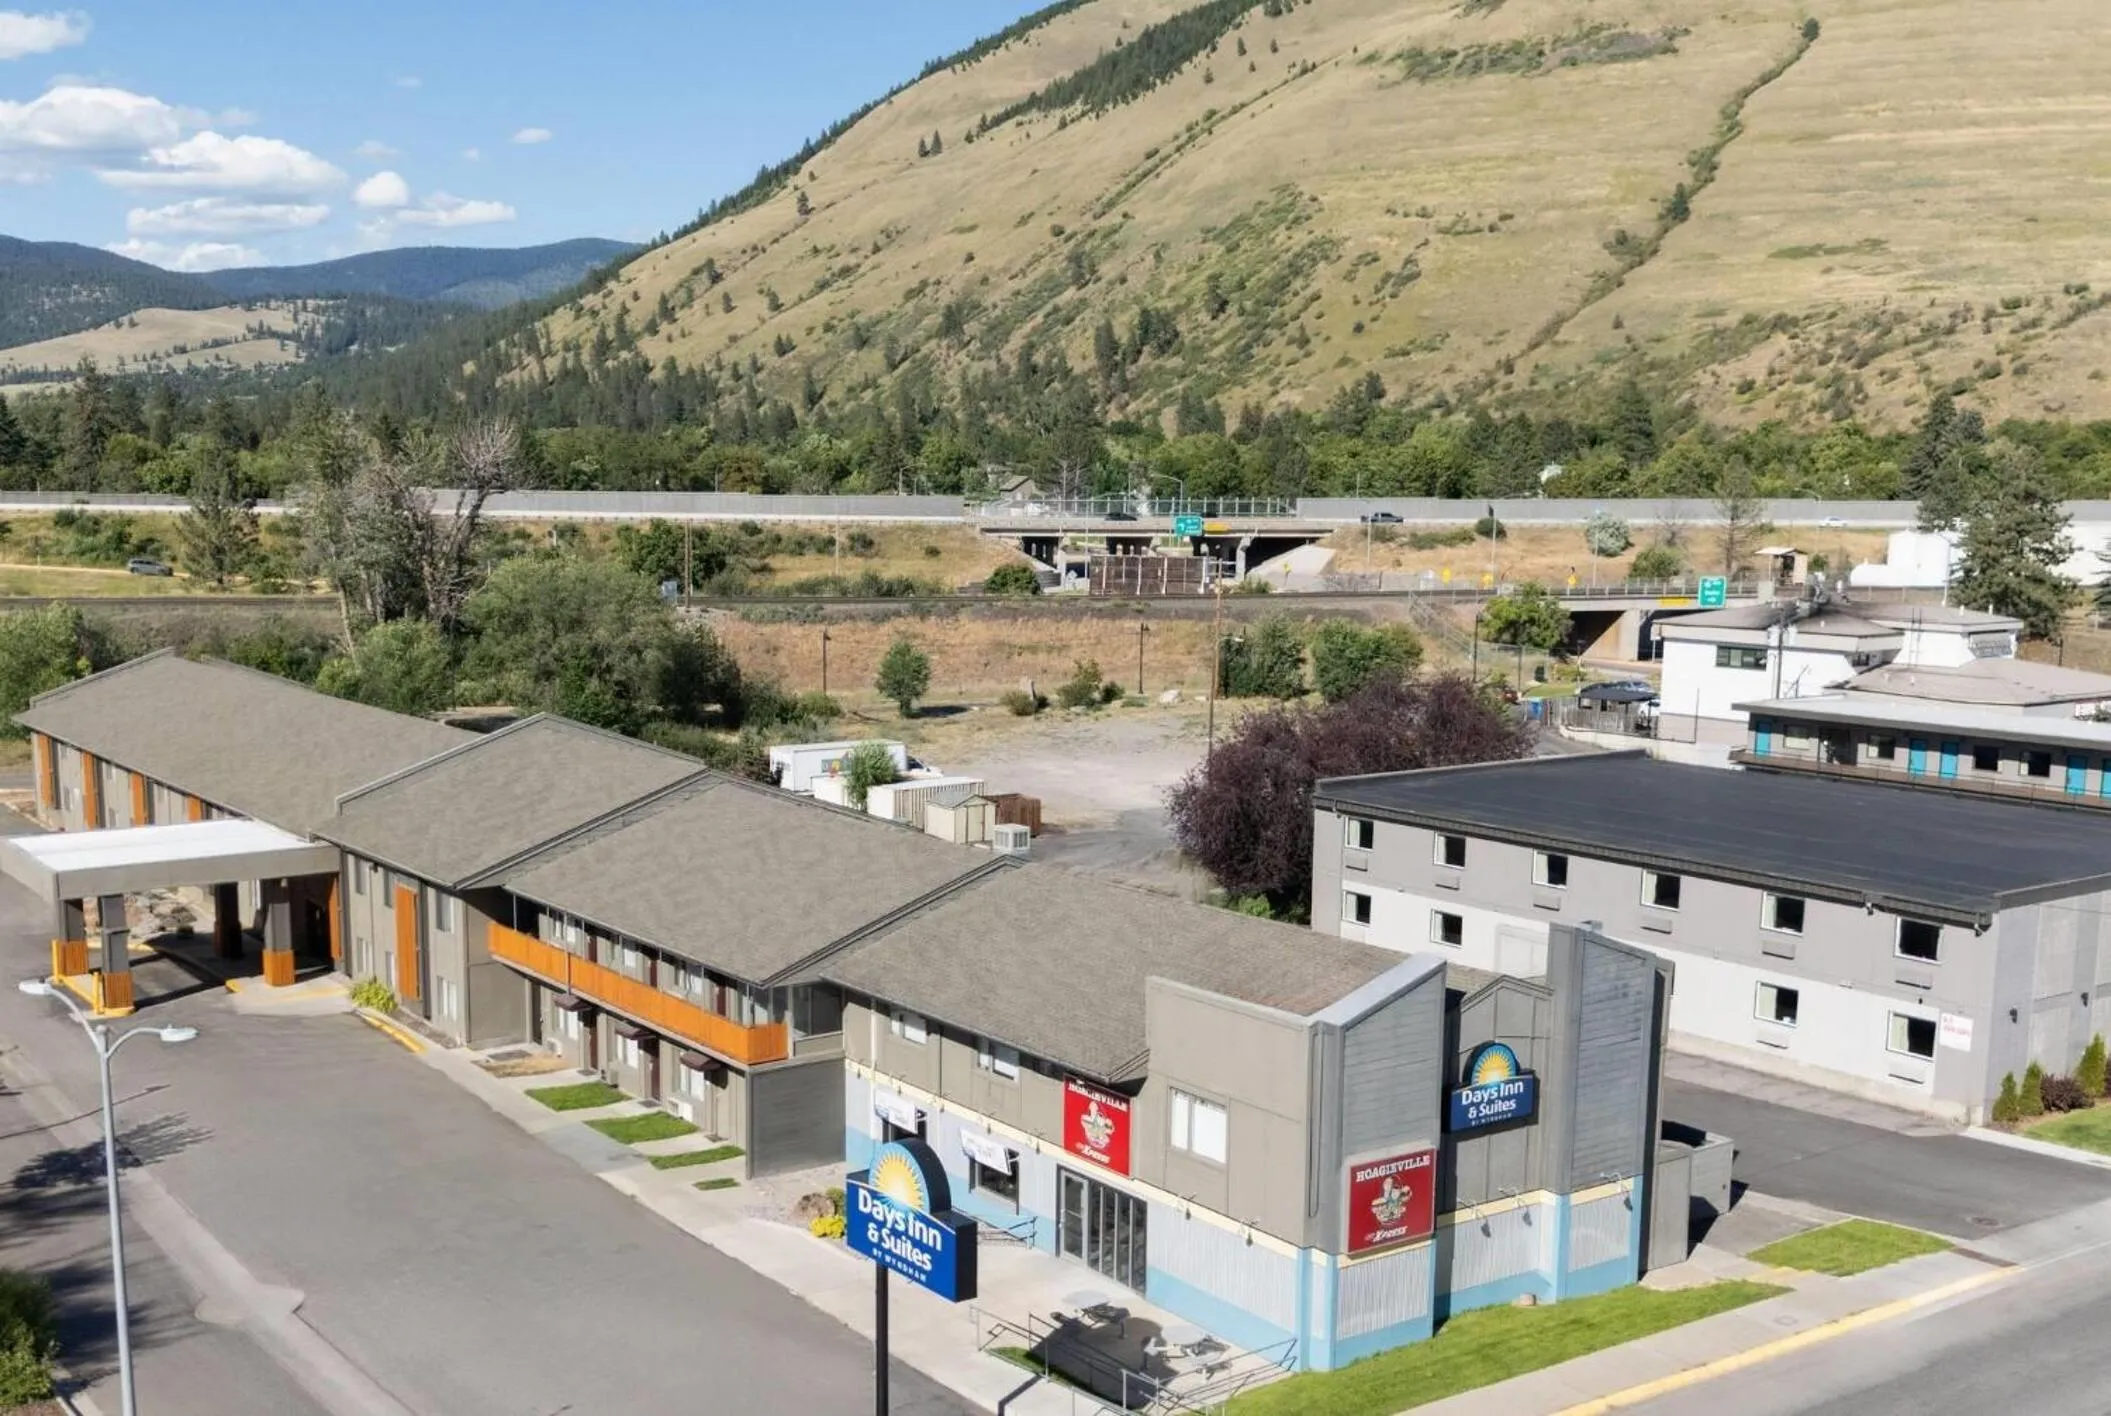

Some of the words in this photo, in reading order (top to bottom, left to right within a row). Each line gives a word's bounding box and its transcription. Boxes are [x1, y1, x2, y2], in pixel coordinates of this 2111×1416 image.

[1461, 1086, 1498, 1105] Days
[1500, 1081, 1524, 1097] Inn
[1468, 1106, 1477, 1119] &
[1478, 1099, 1516, 1117] Suites
[1356, 1155, 1430, 1182] HOAGIEVILLE
[858, 1188, 906, 1231] Days
[908, 1212, 942, 1250] Inn
[867, 1222, 879, 1242] &
[881, 1228, 932, 1271] Suites
